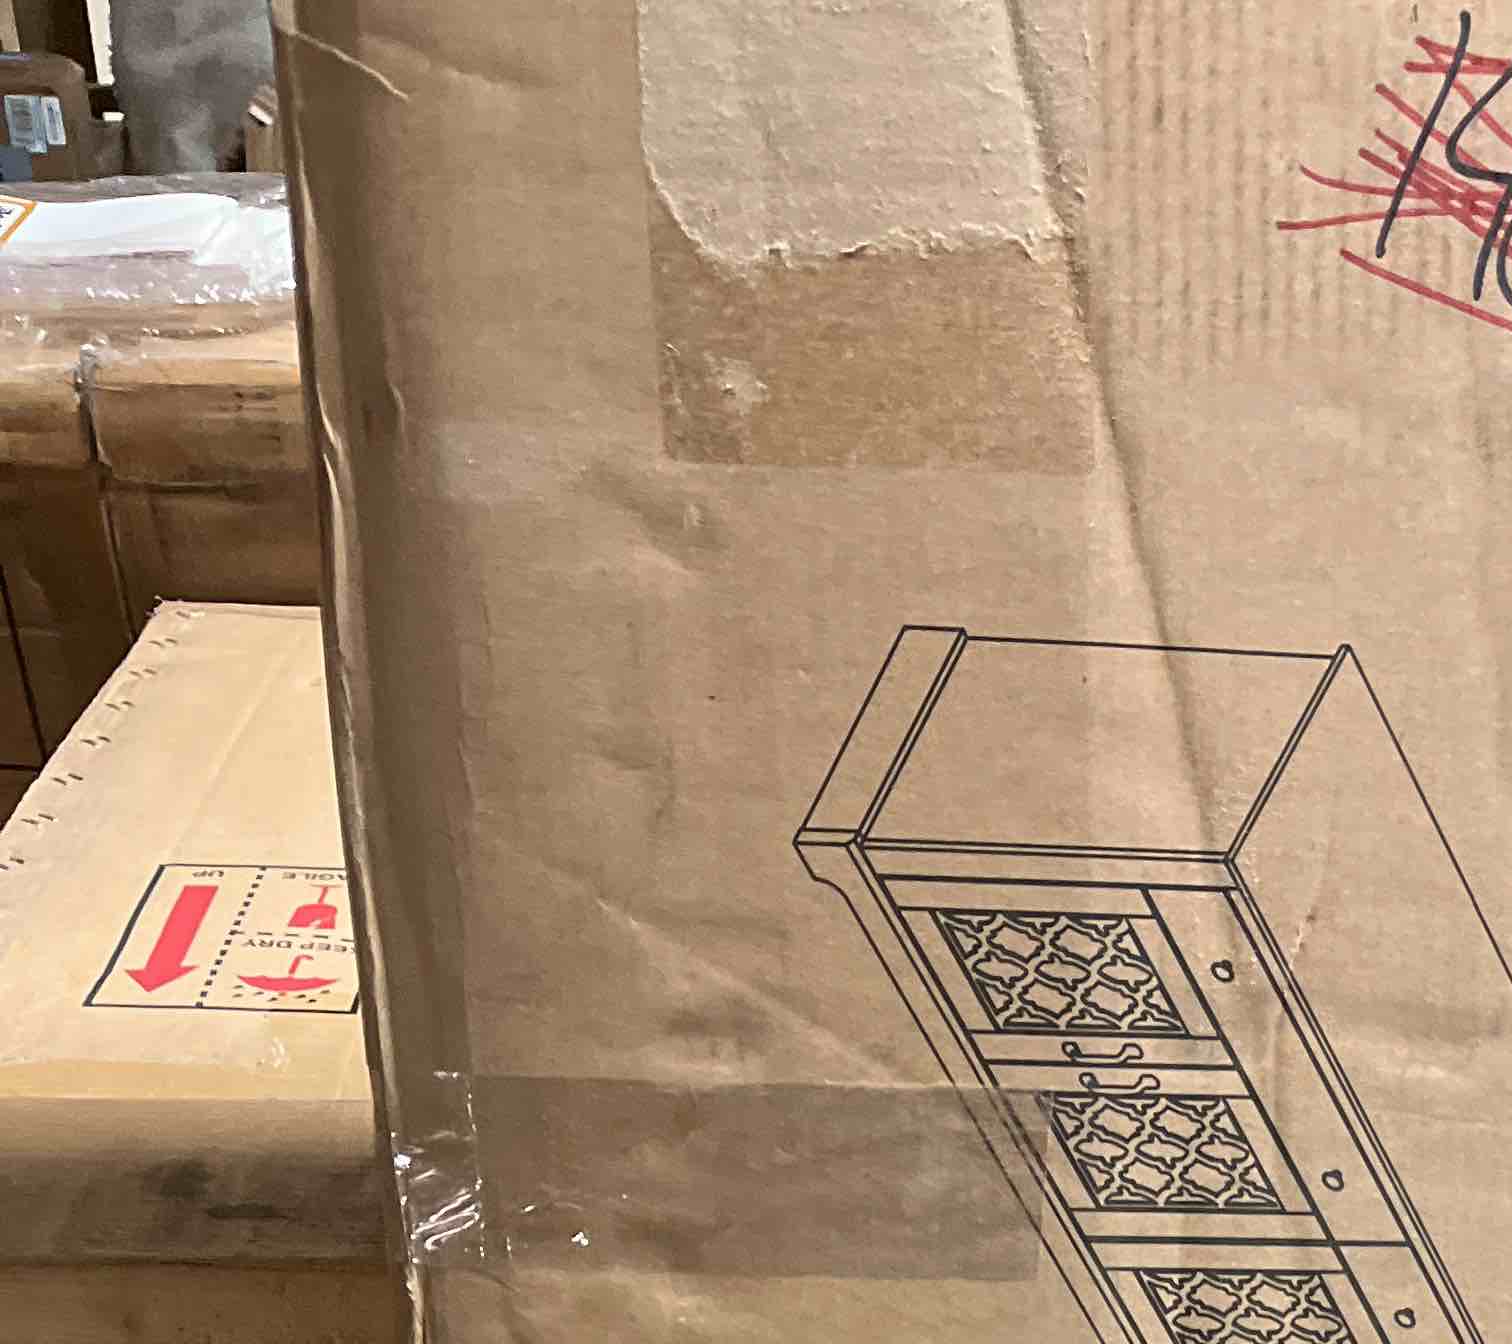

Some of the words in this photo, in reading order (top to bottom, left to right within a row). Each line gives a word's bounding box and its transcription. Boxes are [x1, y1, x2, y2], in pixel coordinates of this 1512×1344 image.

[281, 871, 346, 881] AGILE
[240, 938, 293, 950] DRY
[300, 942, 354, 953] EEP
